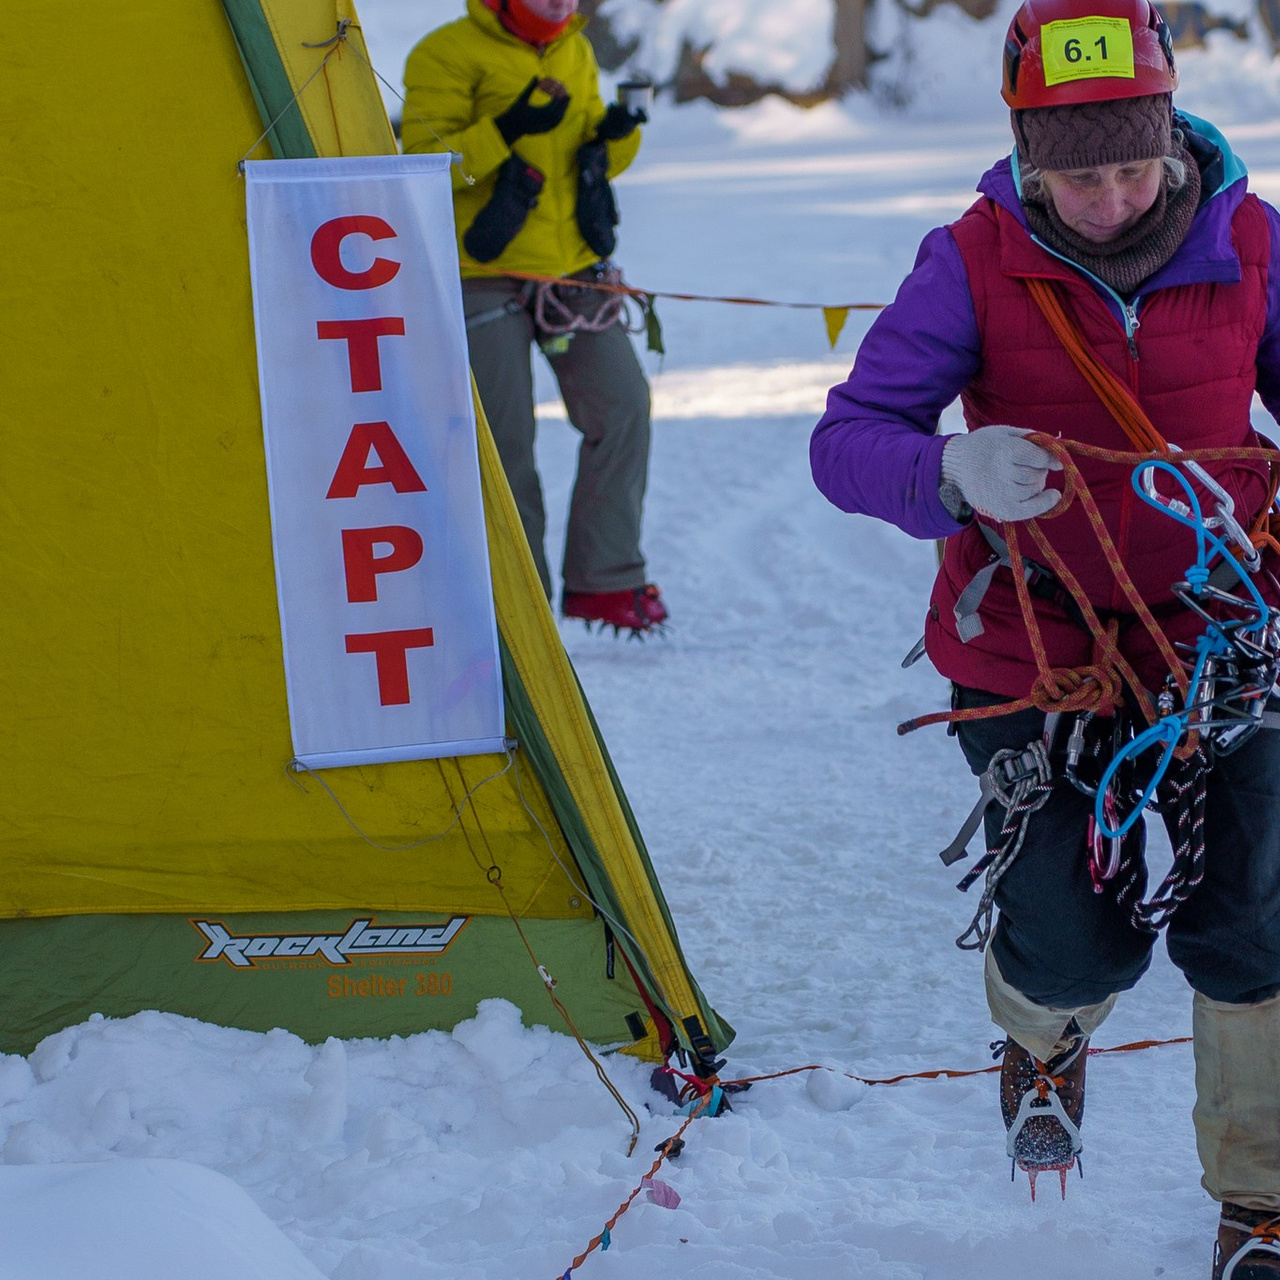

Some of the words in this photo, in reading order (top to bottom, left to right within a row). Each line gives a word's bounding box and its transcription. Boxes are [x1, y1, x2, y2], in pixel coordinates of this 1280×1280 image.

[1064, 36, 1108, 63] 6.1
[310, 215, 434, 707] СТАРТ
[326, 974, 408, 999] Shelter
[414, 972, 454, 996] 380
